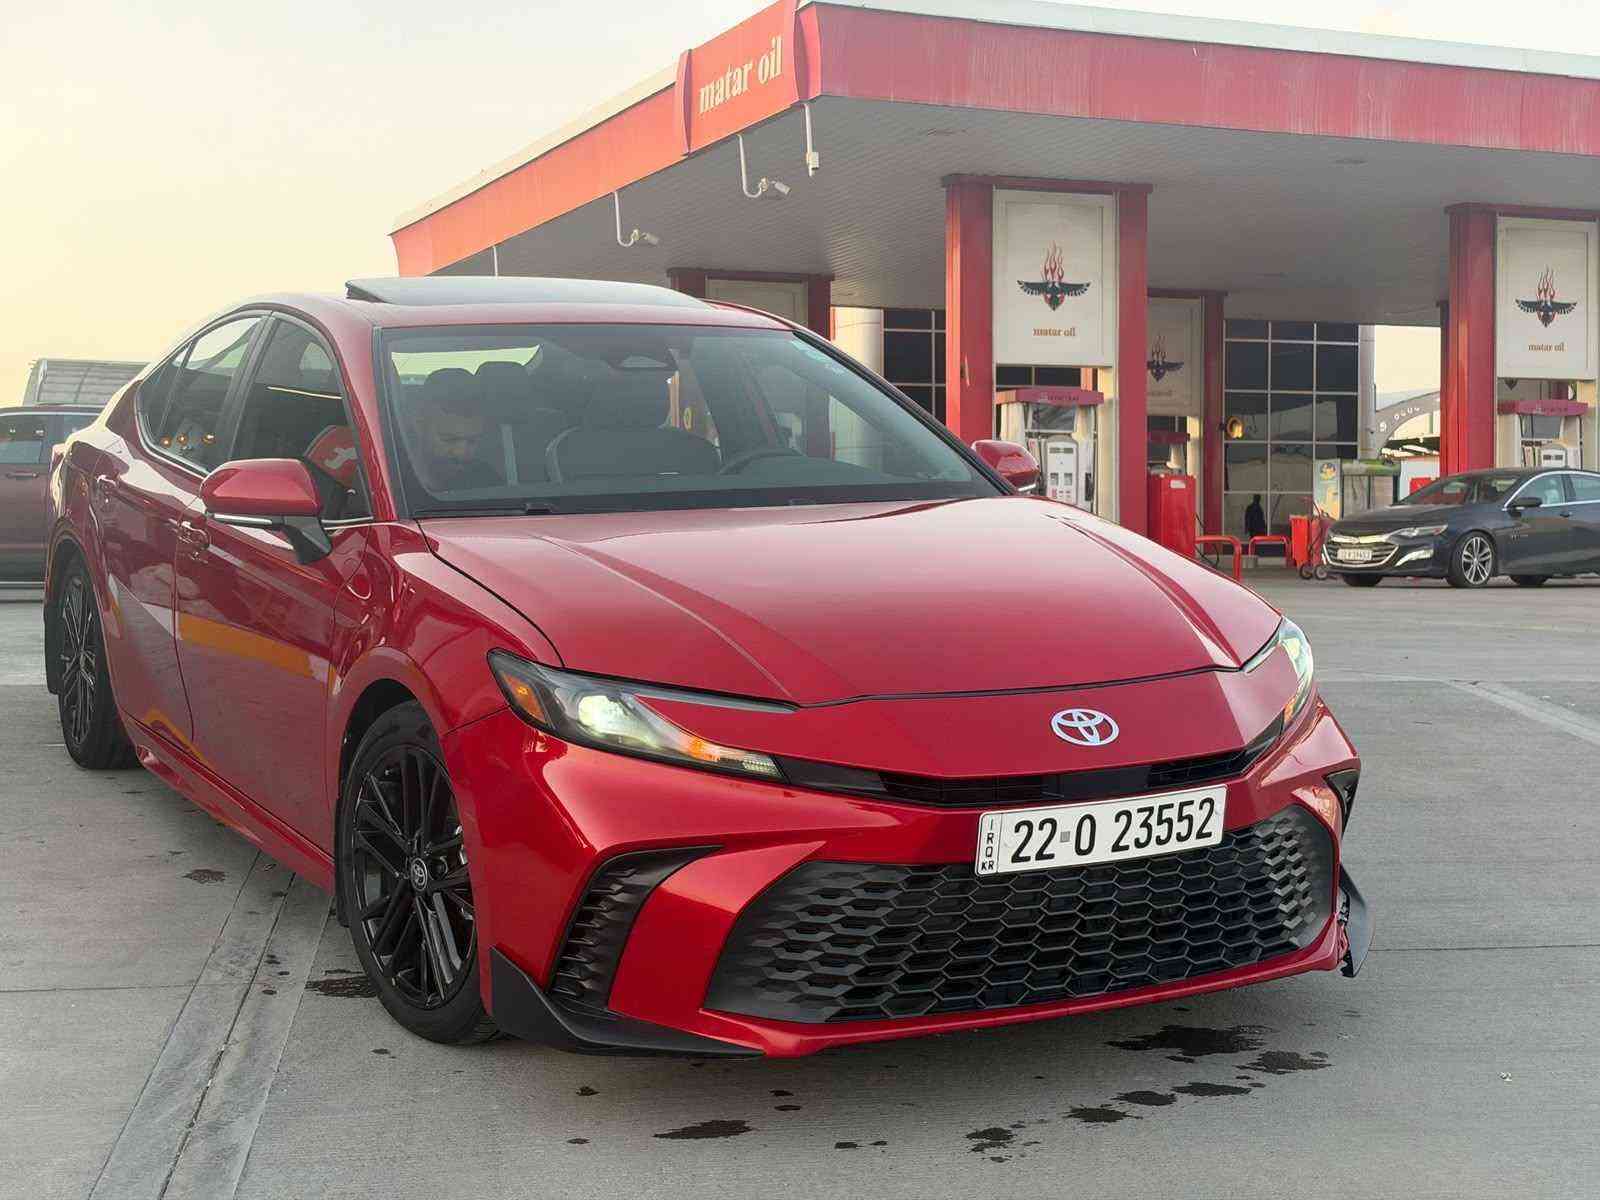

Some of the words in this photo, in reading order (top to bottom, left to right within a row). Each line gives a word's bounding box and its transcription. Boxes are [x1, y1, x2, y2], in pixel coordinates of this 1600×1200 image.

[699, 61, 753, 114] matar
[758, 35, 782, 85] oil
[1063, 326, 1076, 337] oil
[1111, 796, 1216, 853] 23552
